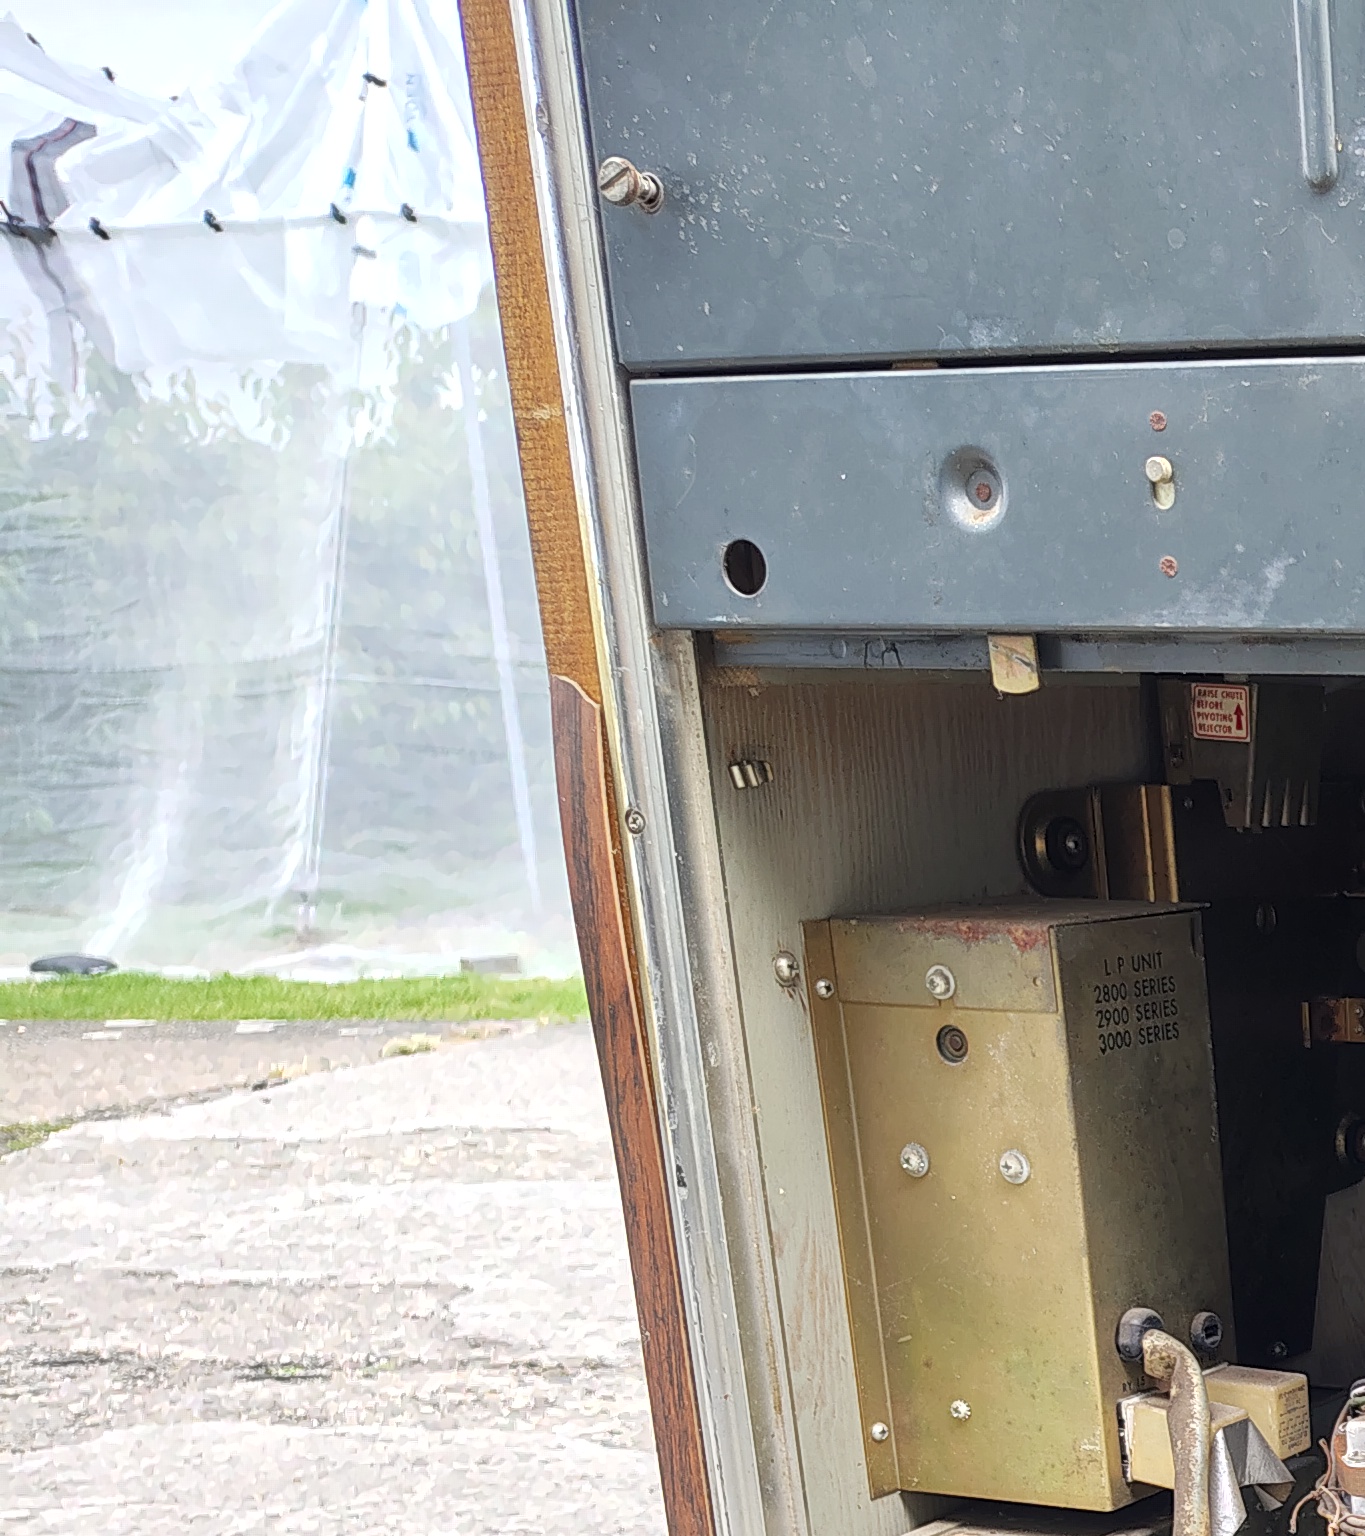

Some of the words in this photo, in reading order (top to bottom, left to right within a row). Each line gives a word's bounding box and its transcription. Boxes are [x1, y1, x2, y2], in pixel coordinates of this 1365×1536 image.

[1197, 688, 1218, 699] RAISE
[1222, 690, 1244, 700] CHUTE
[1197, 700, 1224, 710] BEFORE
[1197, 712, 1234, 722] PIVOTING
[1198, 723, 1232, 734] REJECTOR
[1132, 952, 1162, 972] UNIT
[1094, 983, 1127, 1004] 2800
[1134, 976, 1176, 998] SERIES
[1095, 1006, 1130, 1028] 2900
[1136, 999, 1178, 1022] SERIES
[1099, 1030, 1132, 1055] 3000
[1138, 1022, 1180, 1045] SERIES
